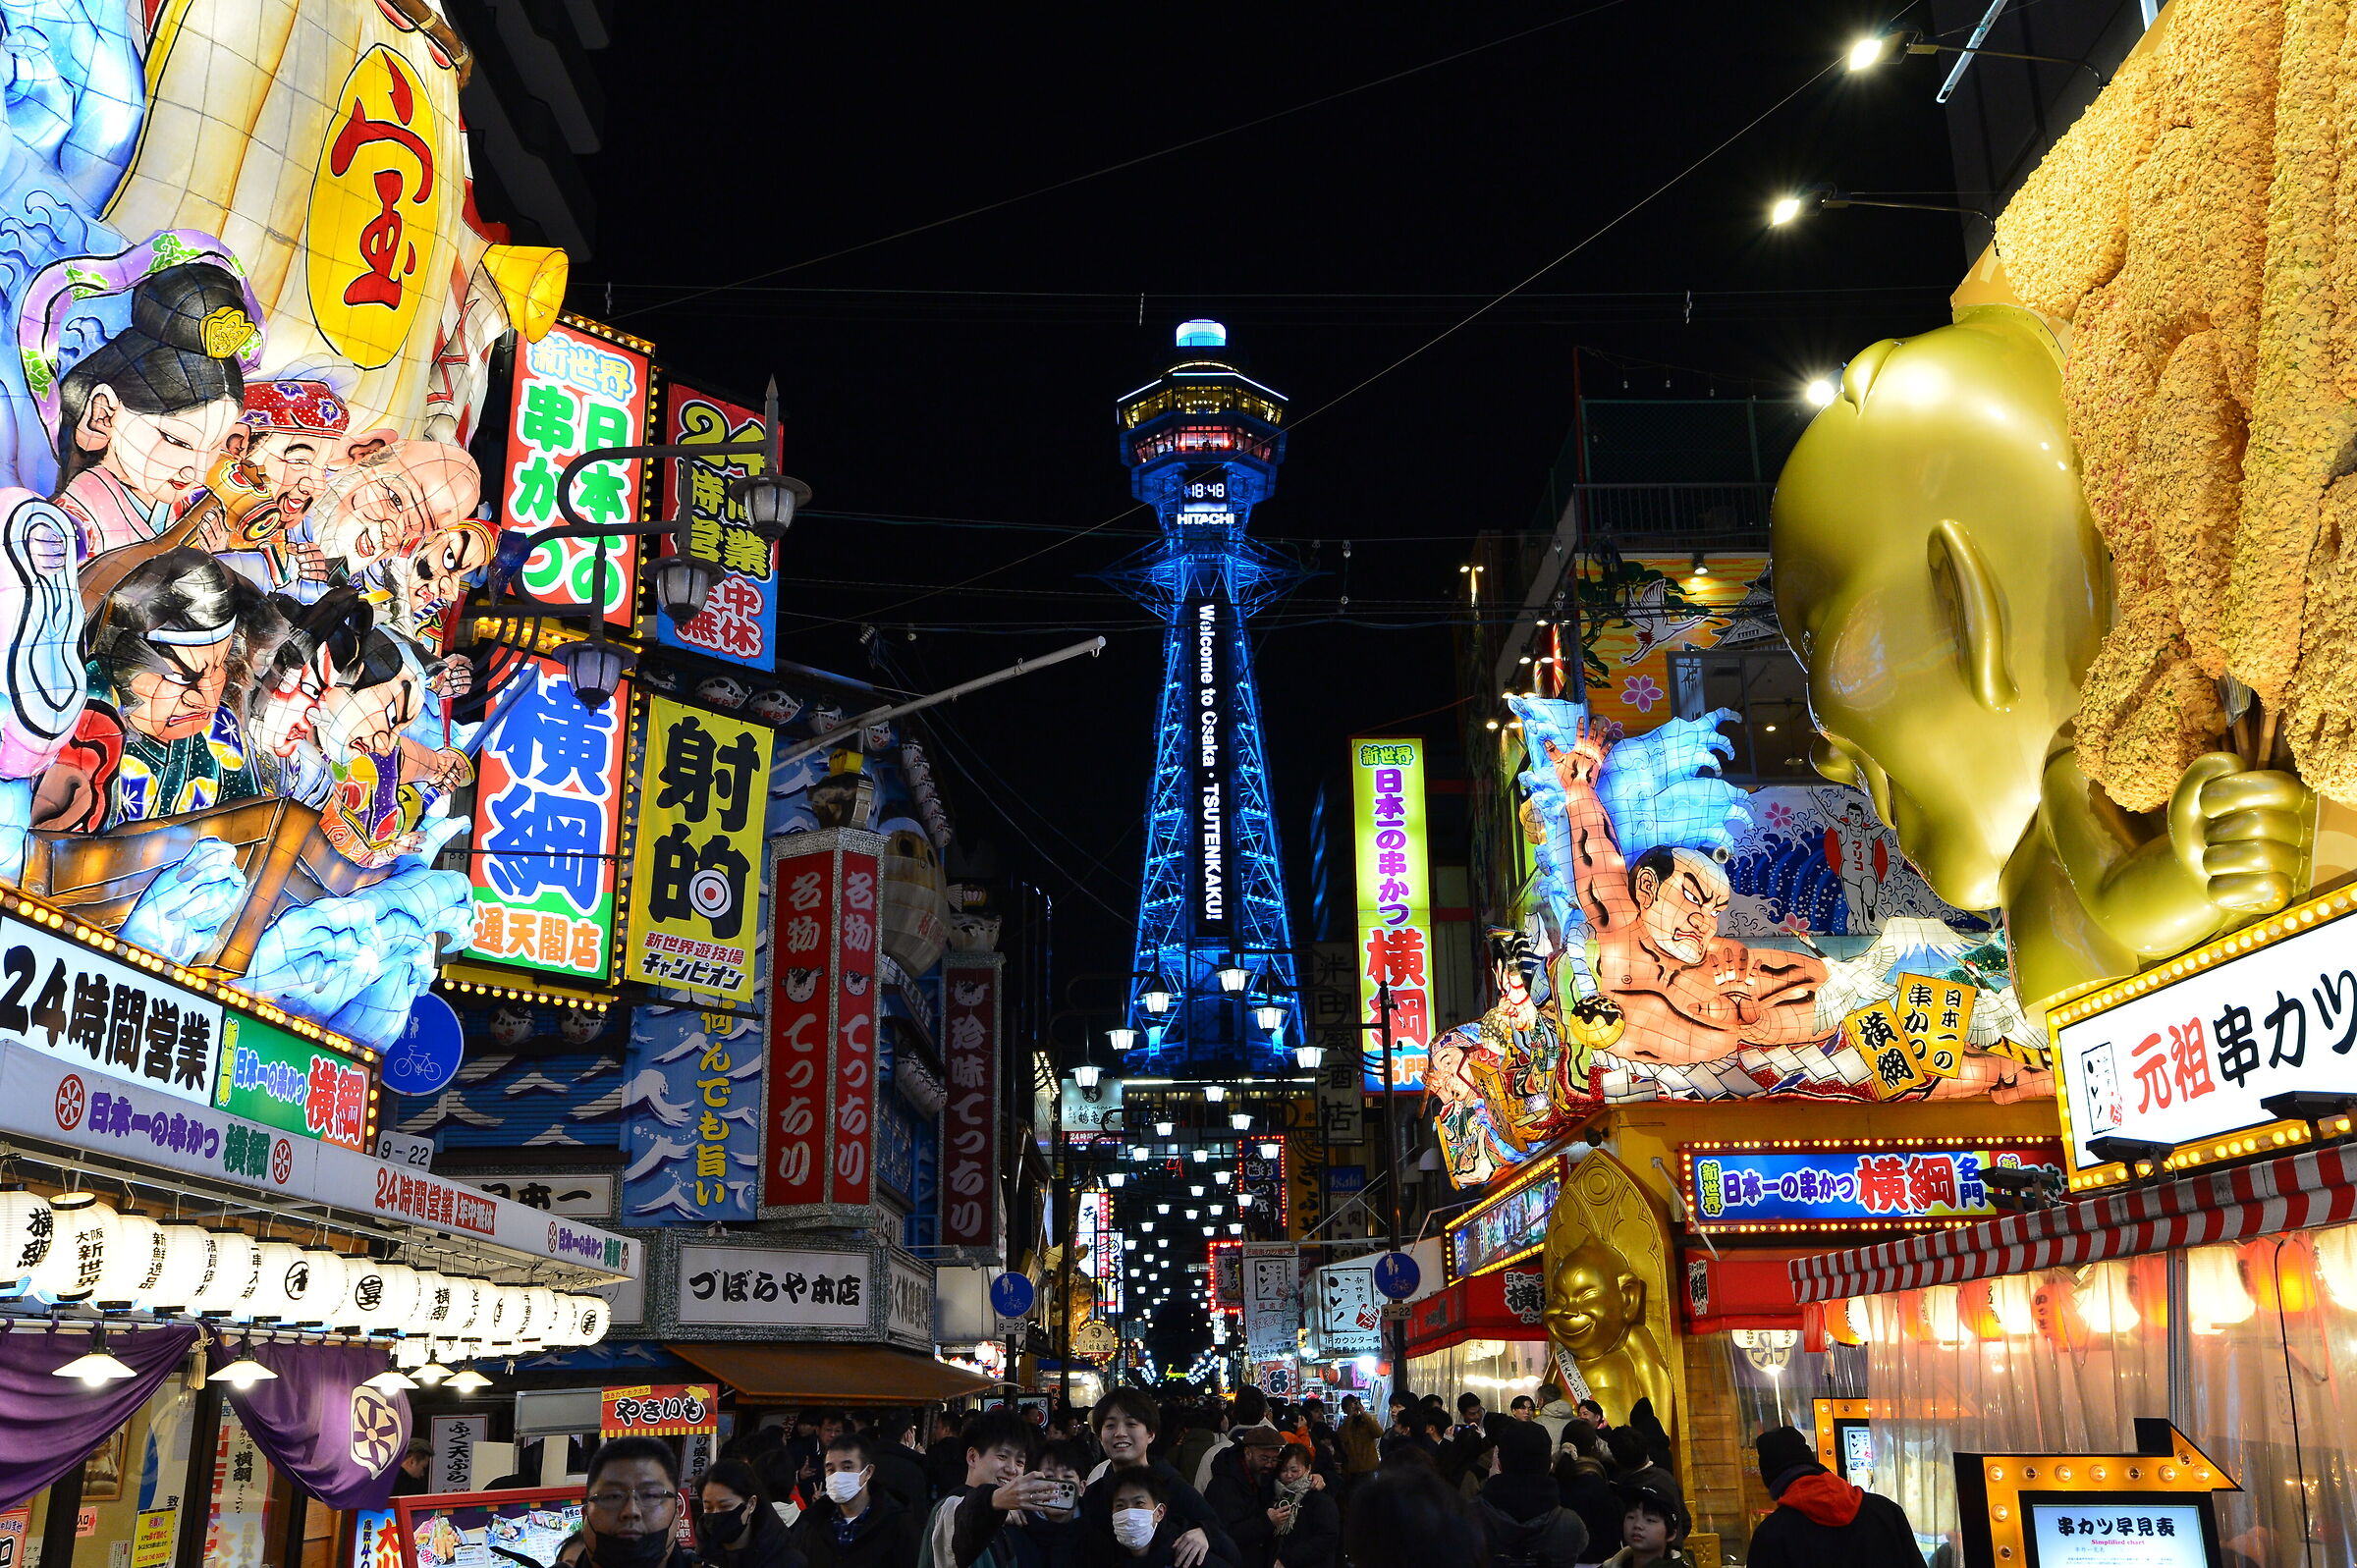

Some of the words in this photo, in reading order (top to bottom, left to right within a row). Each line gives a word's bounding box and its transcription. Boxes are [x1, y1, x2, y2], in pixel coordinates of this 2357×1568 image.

[531, 339, 631, 399] 新世界
[516, 384, 576, 589] 串かつ
[1191, 483, 1225, 498] 18:48
[1177, 514, 1234, 524] HITACHI
[682, 613, 761, 655] 無休
[1199, 604, 1215, 684] Welcome
[1201, 688, 1216, 707] to
[1201, 711, 1218, 767] Osaka
[1361, 745, 1414, 766] 新世界
[488, 668, 614, 910] 横綱
[648, 716, 761, 940] 射的
[1203, 783, 1223, 920] TSUTENKAKU!
[1375, 769, 1410, 926] 日本一の串かつ
[472, 905, 601, 969] 通天閣店
[788, 871, 821, 955] 名物
[845, 871, 874, 955] 名物
[642, 952, 744, 990] チャンピオン
[644, 932, 744, 964] 新世界遊技場
[1, 945, 211, 1092] 24時間営業
[1366, 929, 1428, 1049] 横綱
[1858, 1010, 1915, 1090] 横綱
[1904, 983, 1933, 1060] 串かつ
[1933, 989, 1962, 1069] 日本一の
[2131, 969, 2357, 1115] 元祖串カツ
[235, 1052, 306, 1105] 日本一の串かつ
[305, 1056, 367, 1144] 横綱
[695, 1000, 737, 1208] 何んでも旨い
[779, 1012, 819, 1187] てっちり
[838, 1012, 871, 1187] てっちり
[87, 1092, 220, 1160] 日本一の串かつ
[223, 1123, 271, 1180] 横綱
[949, 1014, 987, 1238] 珍味てっちり
[374, 1166, 455, 1225] 24時間営業
[1700, 1162, 1722, 1216] 新世界
[1723, 1169, 1855, 1204] 日本一の串かつ
[1856, 1156, 1956, 1211] 横綱
[1956, 1157, 1985, 1209] 名門
[16, 1207, 54, 1269] 横綱
[76, 1227, 104, 1244] 大阪
[77, 1244, 104, 1290] 新世界
[688, 1269, 862, 1308] づぼらや本店
[615, 1397, 706, 1427] やきいも
[2057, 1516, 2176, 1538] 串カツ早見表
